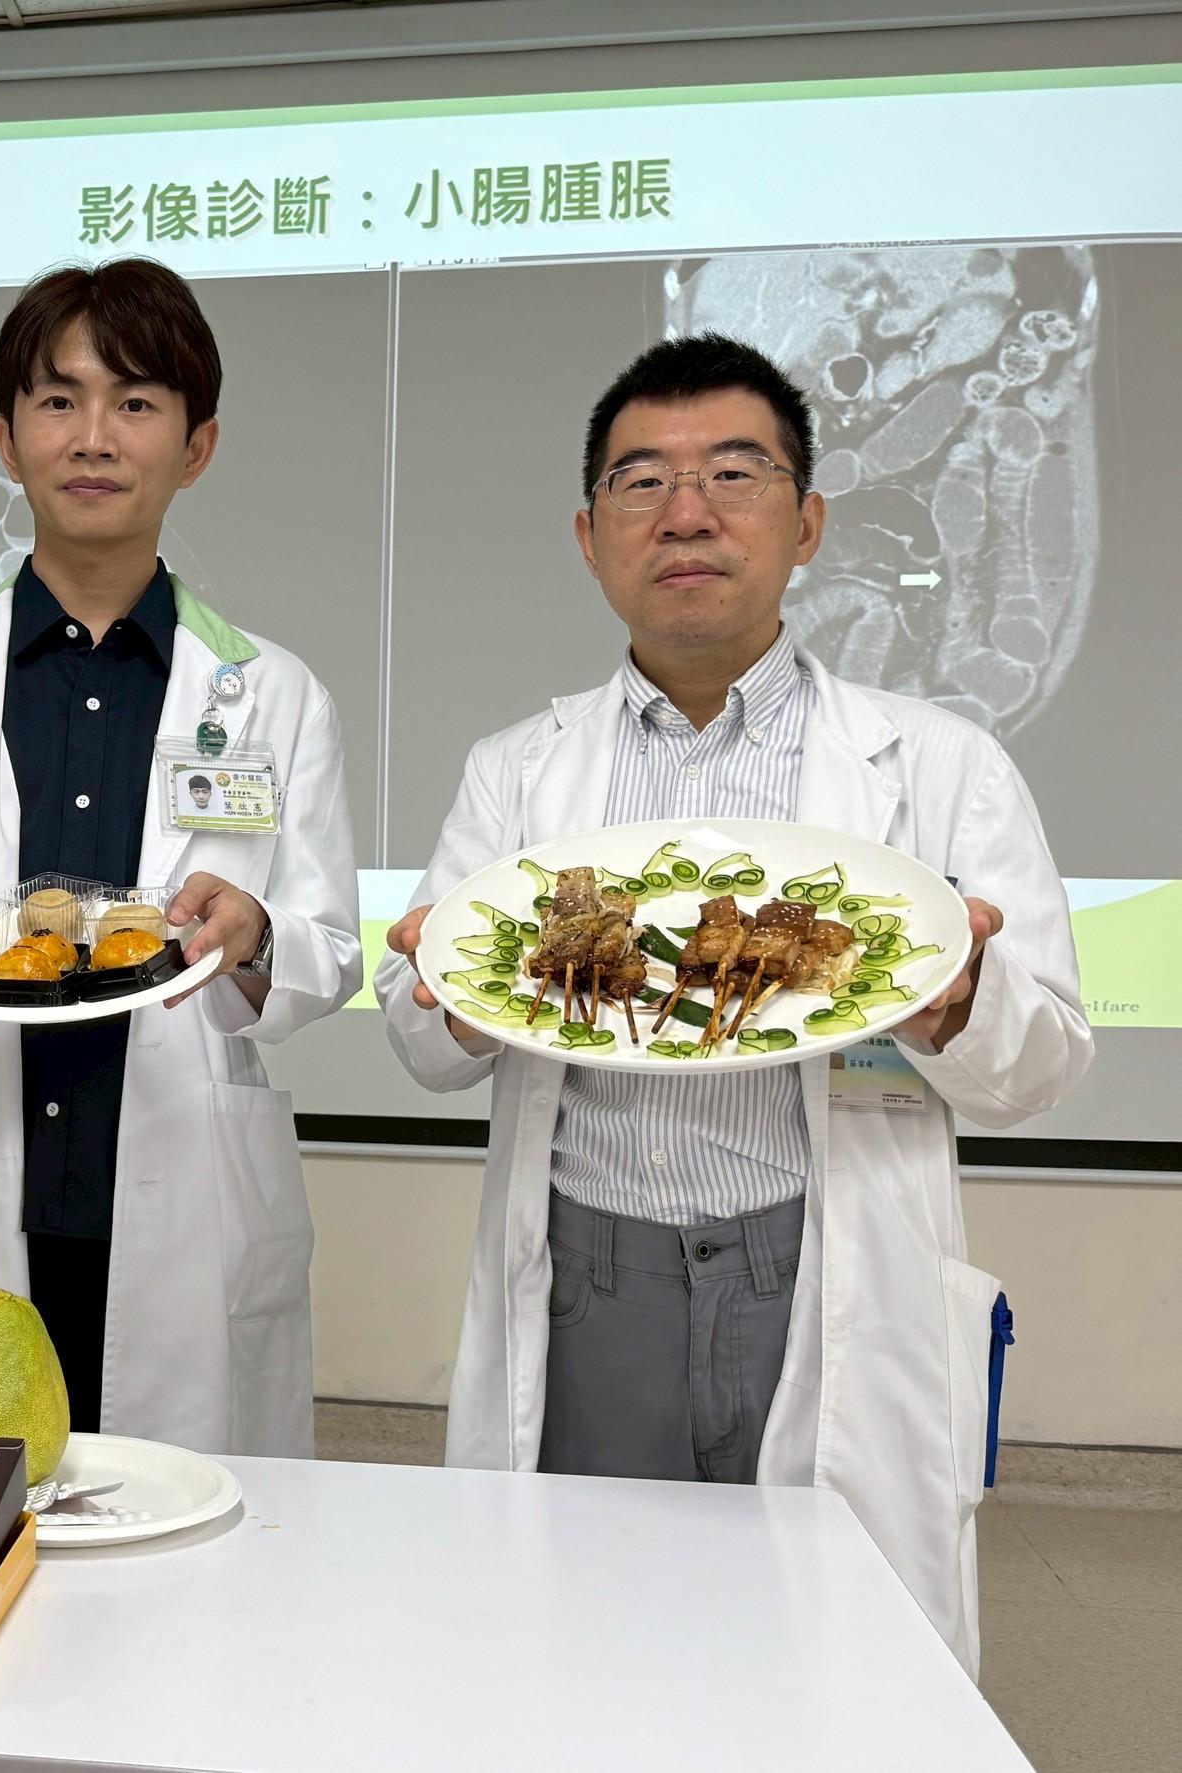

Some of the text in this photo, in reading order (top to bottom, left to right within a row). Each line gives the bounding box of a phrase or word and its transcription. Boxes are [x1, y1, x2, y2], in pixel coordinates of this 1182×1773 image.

[78, 157, 672, 245] 影像診斷：小腸腫脹
[1082, 1000, 1140, 1013] elfare
